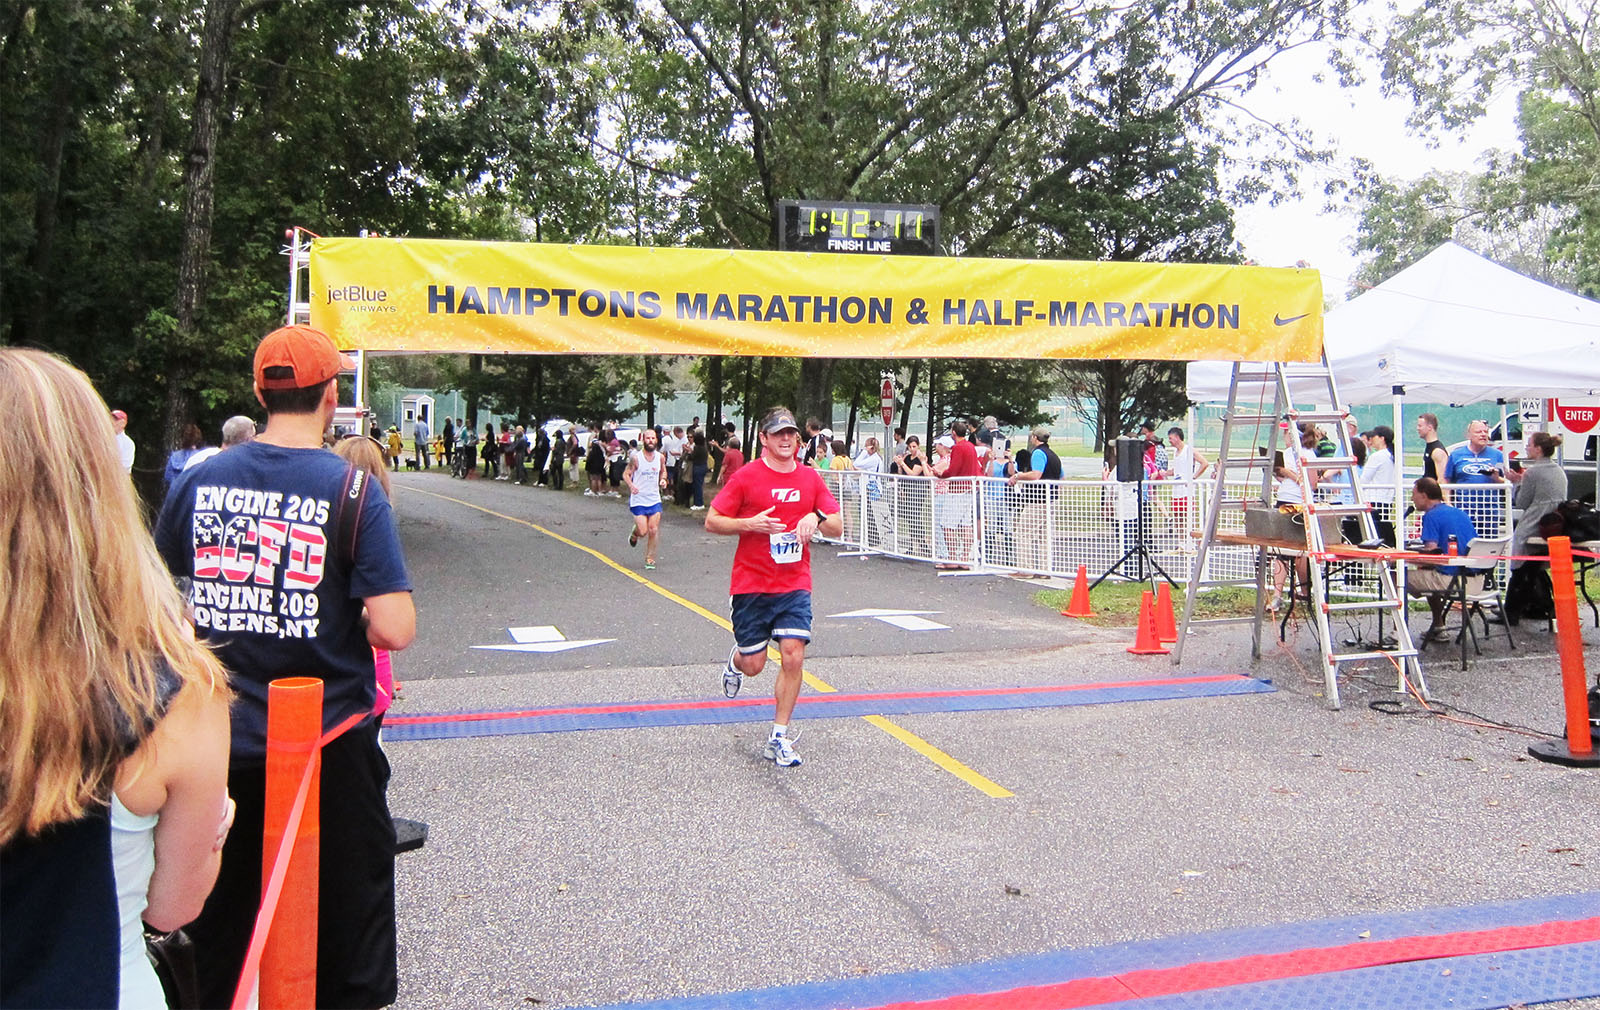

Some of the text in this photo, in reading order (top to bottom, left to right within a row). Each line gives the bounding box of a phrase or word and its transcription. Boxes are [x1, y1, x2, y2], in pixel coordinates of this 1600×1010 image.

[827, 239, 891, 252] FINISH LINE
[327, 285, 387, 304] jetBlue
[350, 305, 397, 313] AIRWAYS
[427, 285, 1240, 330] HAMPTONS MARATHON & HALF-MARATHON
[1521, 401, 1541, 410] WAY
[1565, 410, 1594, 421] ENTER
[349, 470, 364, 498] Canon
[194, 486, 330, 525] ENGINE 205
[776, 542, 800, 555] 1712
[192, 580, 320, 618] ENGINE 209
